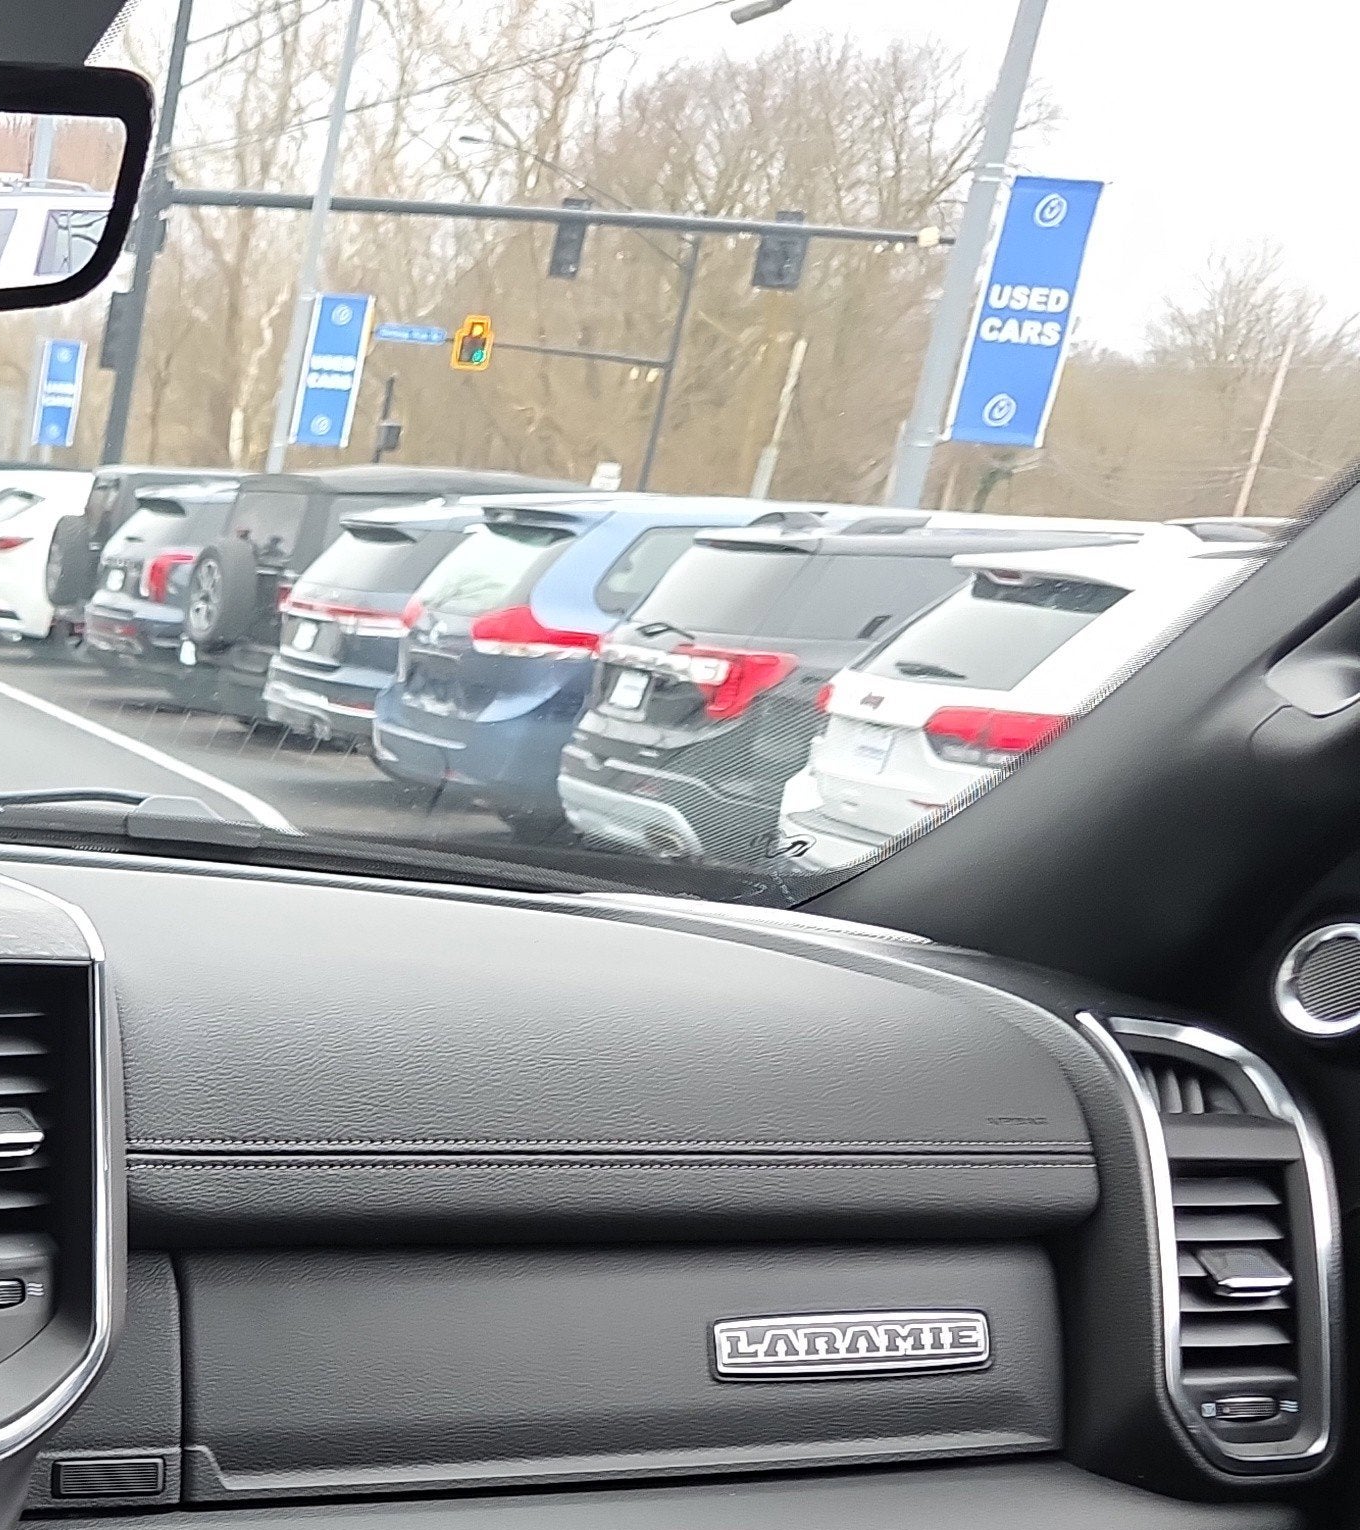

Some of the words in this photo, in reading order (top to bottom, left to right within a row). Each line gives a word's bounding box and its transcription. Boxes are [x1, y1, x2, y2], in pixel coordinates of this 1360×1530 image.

[988, 284, 1069, 313] USED
[980, 317, 1061, 347] CARS
[724, 1322, 982, 1361] LARAMIE
